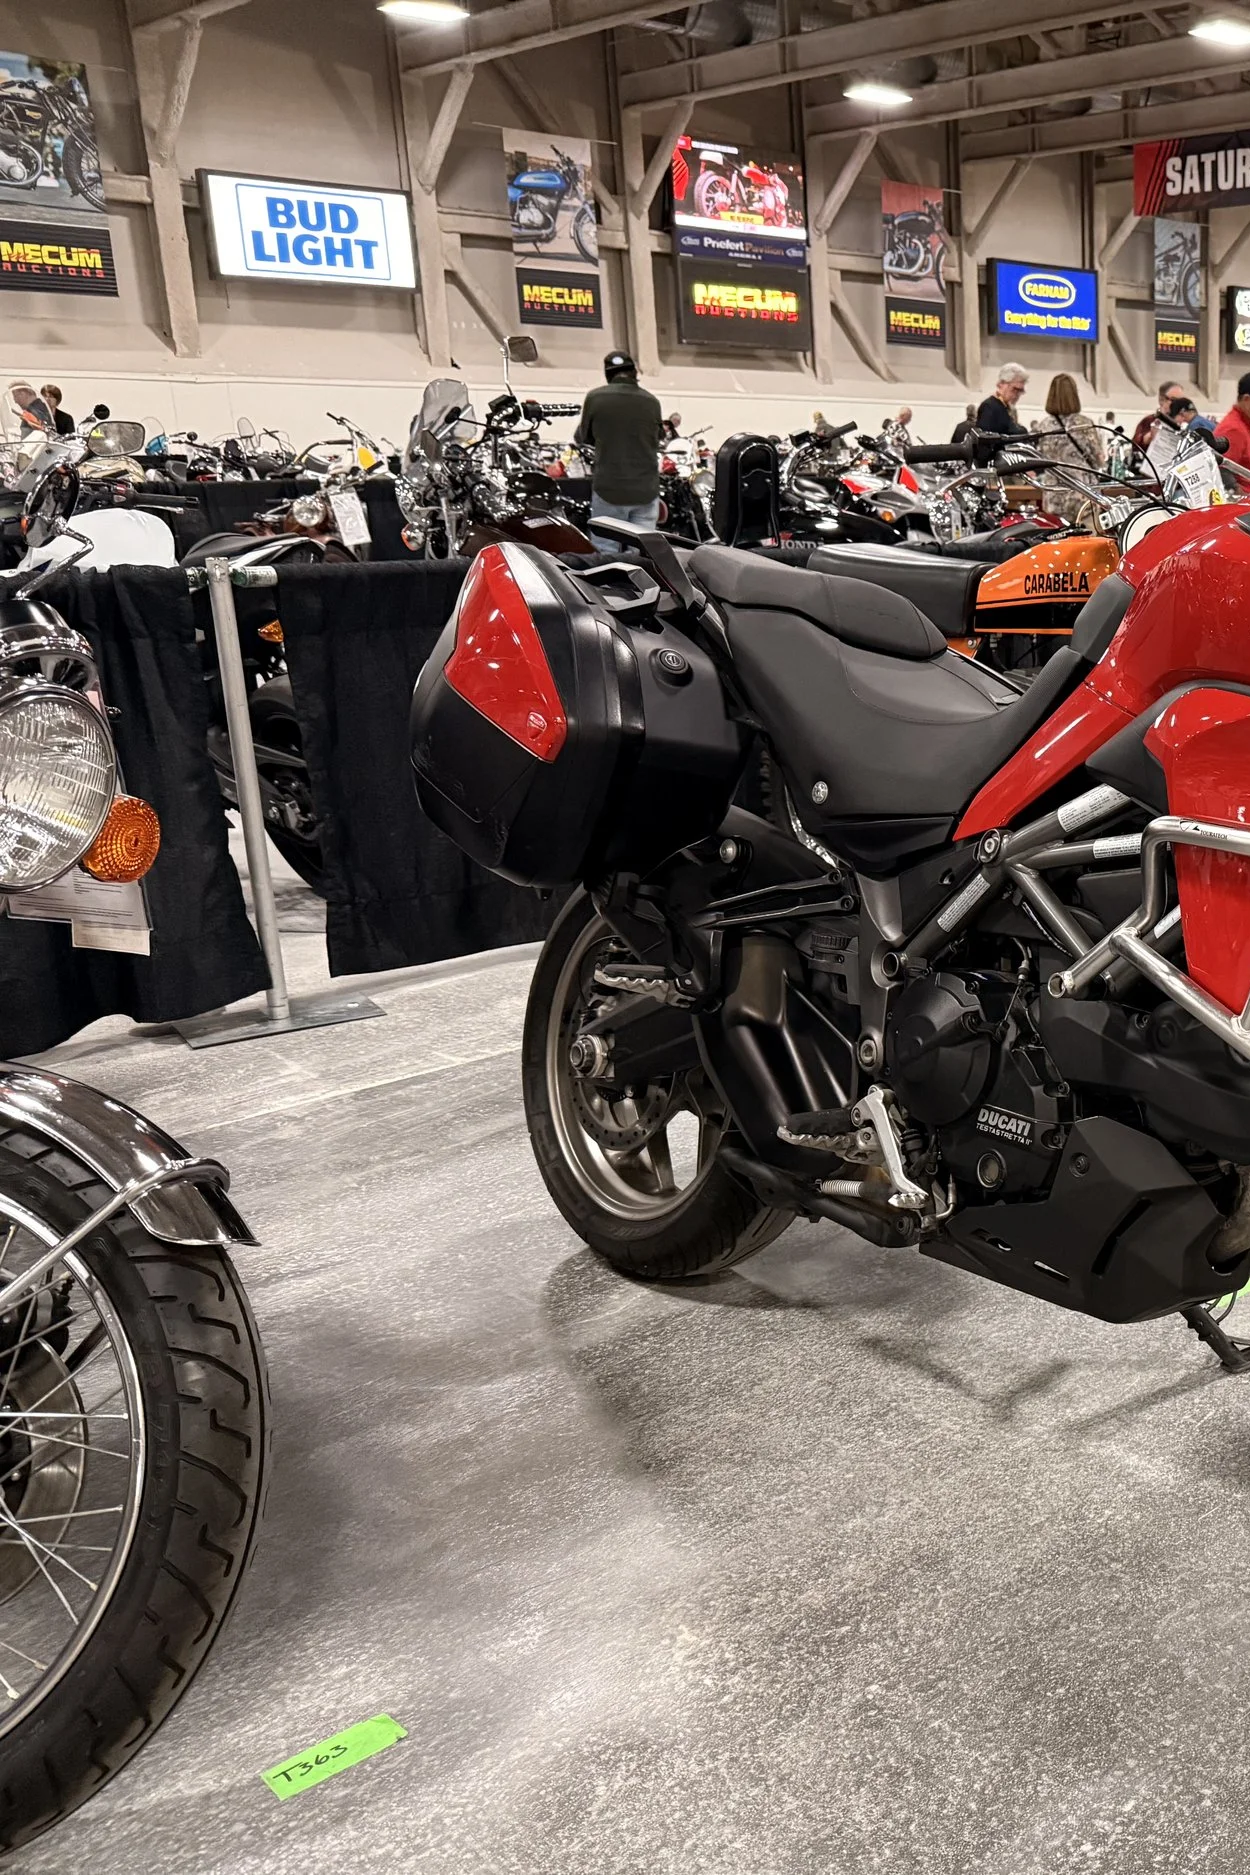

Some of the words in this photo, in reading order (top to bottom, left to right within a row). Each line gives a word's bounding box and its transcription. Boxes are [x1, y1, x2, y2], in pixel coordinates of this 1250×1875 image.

[265, 196, 358, 234] BUD
[0, 241, 103, 268] MECUM
[252, 230, 378, 270] LIGHT
[2, 262, 105, 278] AUCTIONS
[522, 284, 593, 306] MECUM
[693, 282, 797, 313] MECUM
[523, 301, 594, 314] AUCTIONS
[694, 303, 798, 322] AUCTIONS
[889, 310, 941, 330] MECUM
[1157, 331, 1196, 347] MECUM
[1024, 572, 1089, 595] CARABELA
[976, 1122, 1025, 1144] TESTASTRETTA
[977, 1108, 1031, 1137] DUCATI
[273, 1745, 347, 1782] T363
